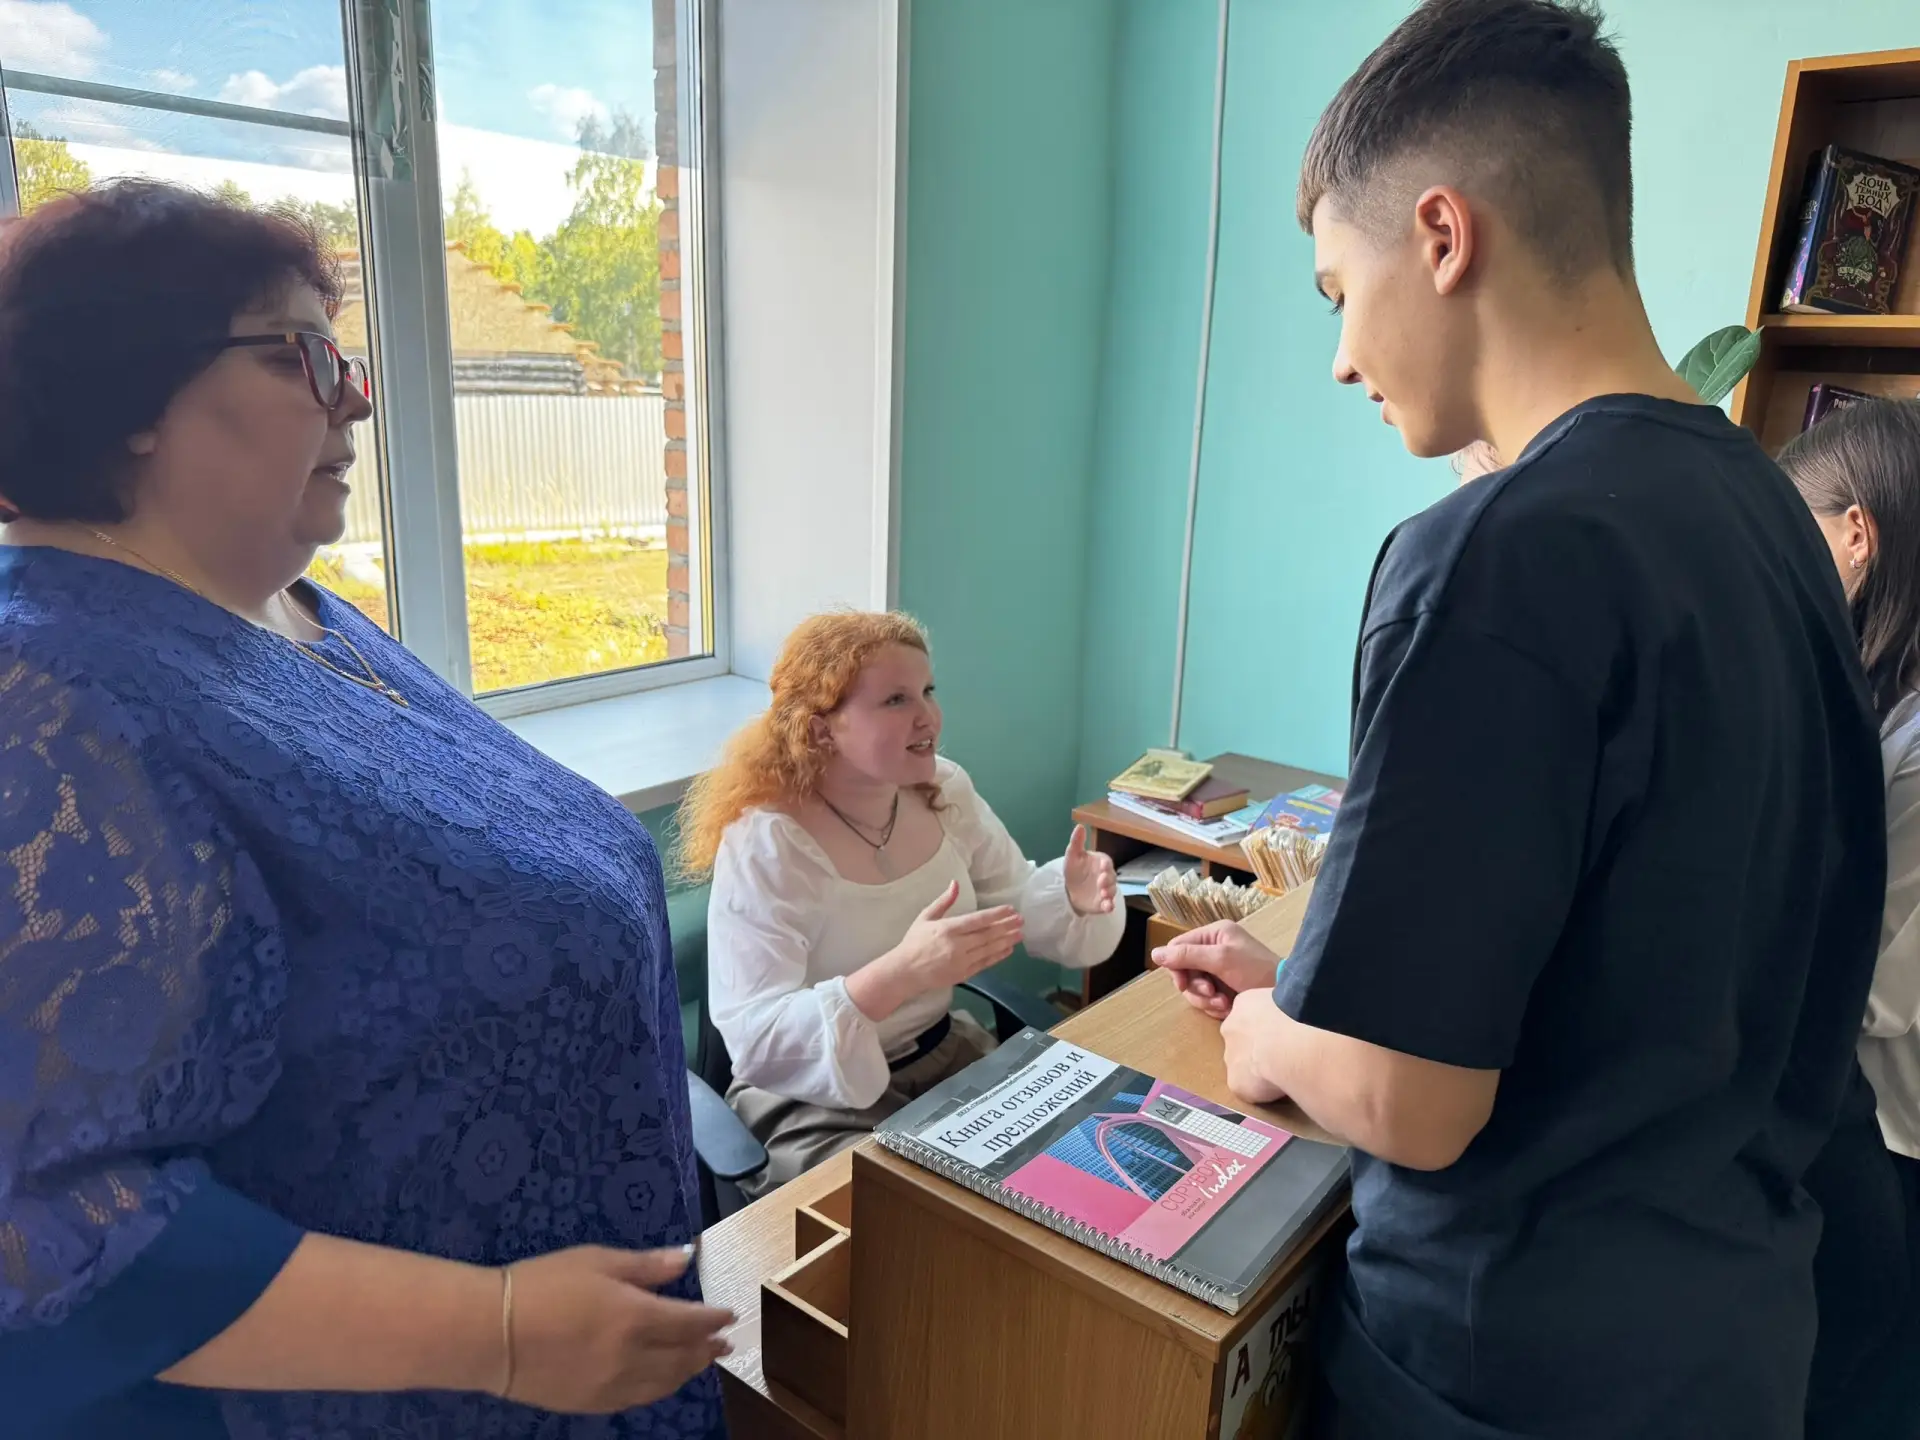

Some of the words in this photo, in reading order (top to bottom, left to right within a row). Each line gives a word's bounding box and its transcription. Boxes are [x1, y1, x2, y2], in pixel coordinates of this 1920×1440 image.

[1858, 195, 1884, 212] ВОД
[1860, 176, 1891, 191] ДОЧЬ
[936, 1108, 1005, 1149] Книга
[1001, 1062, 1071, 1112] отзывов
[1066, 1051, 1086, 1064] и
[982, 1069, 1098, 1153] предложений
[1155, 1101, 1178, 1121] A4
[1160, 1152, 1229, 1212] COPYBOOK
